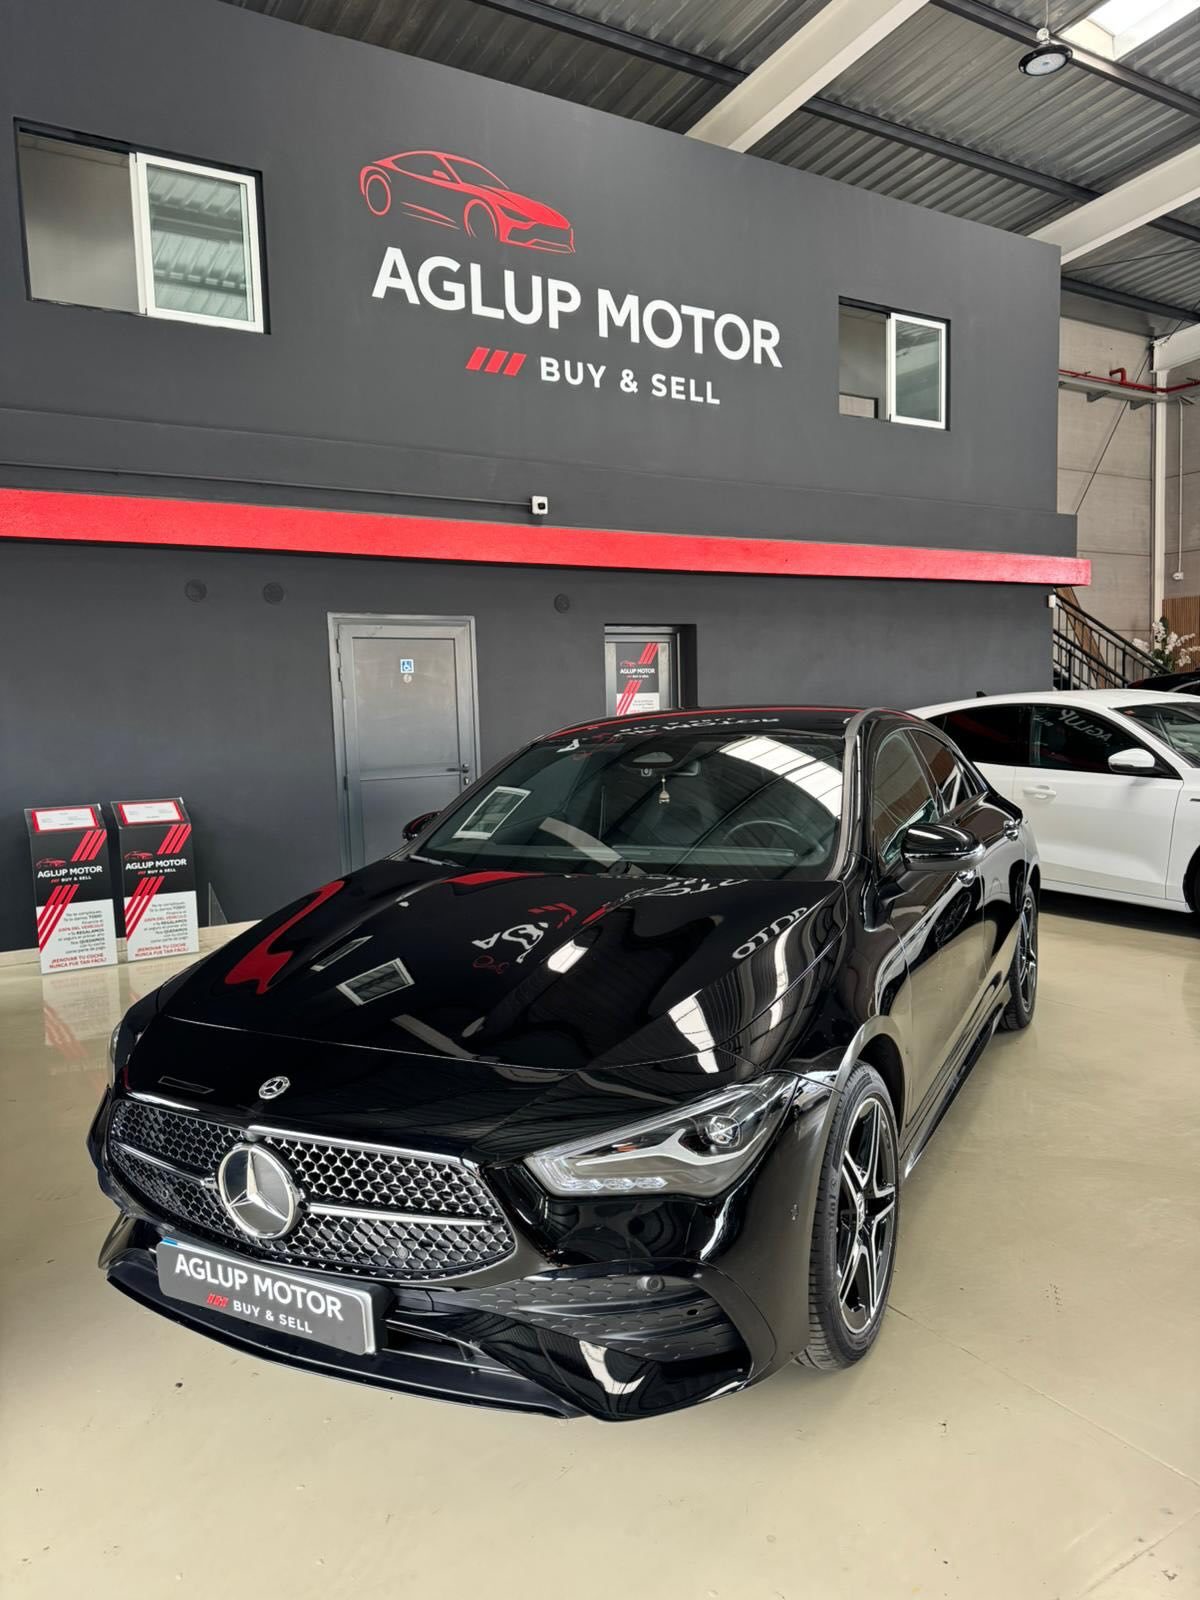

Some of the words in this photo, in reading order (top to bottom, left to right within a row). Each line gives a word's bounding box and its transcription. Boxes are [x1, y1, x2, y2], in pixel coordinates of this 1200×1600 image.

[371, 245, 581, 330] AGLUP
[597, 288, 783, 369] MOTOR
[539, 356, 607, 389] BUY
[619, 368, 639, 394] &
[650, 373, 721, 405] SELL
[37, 868, 68, 879] AGLUP
[69, 865, 103, 875] MOTOR
[125, 860, 154, 871] AGLUP
[155, 858, 188, 867] MOTOR
[174, 1253, 249, 1290] AGLUP
[254, 1273, 344, 1322] MOTOR
[233, 1299, 260, 1317] BUY
[265, 1310, 275, 1322] &
[279, 1313, 313, 1334] SELL
